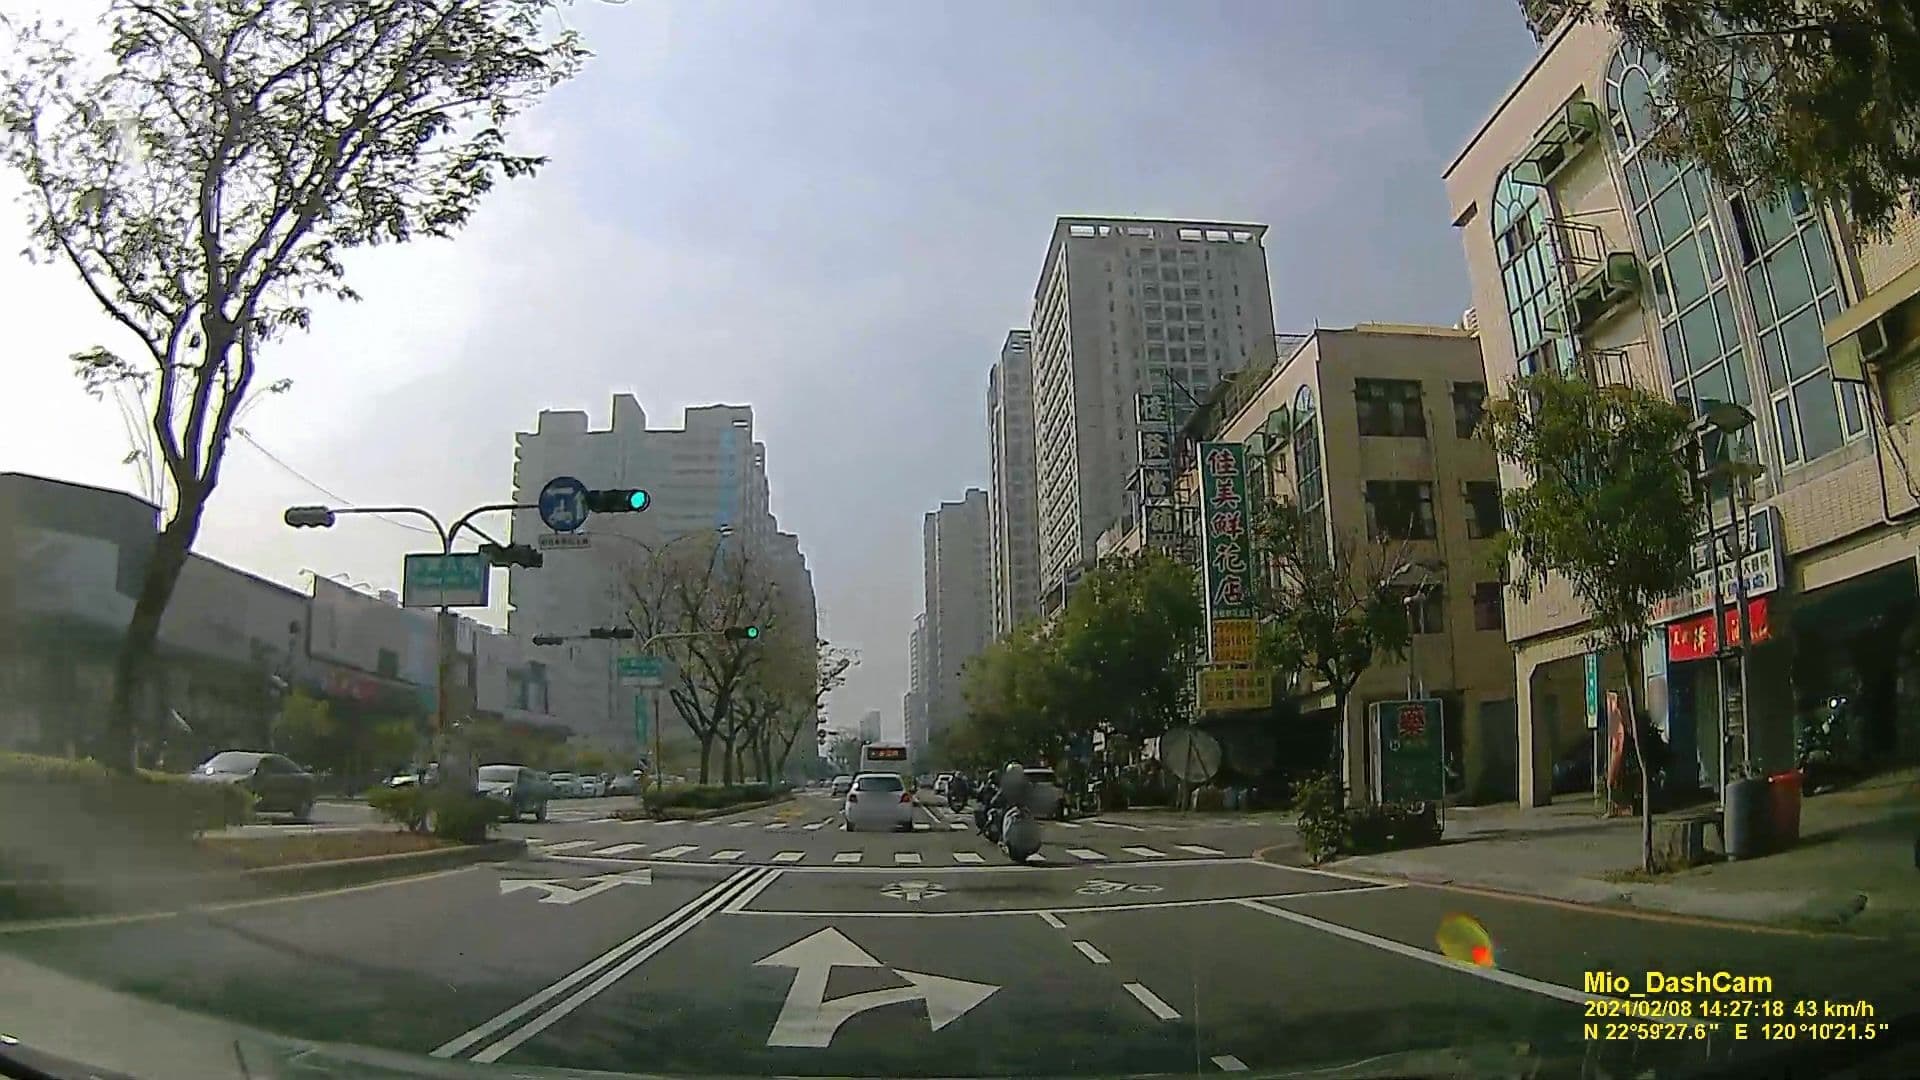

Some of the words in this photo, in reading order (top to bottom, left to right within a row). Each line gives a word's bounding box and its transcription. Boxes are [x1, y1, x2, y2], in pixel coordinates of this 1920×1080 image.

[1206, 447, 1246, 606] 佳美鮮花店
